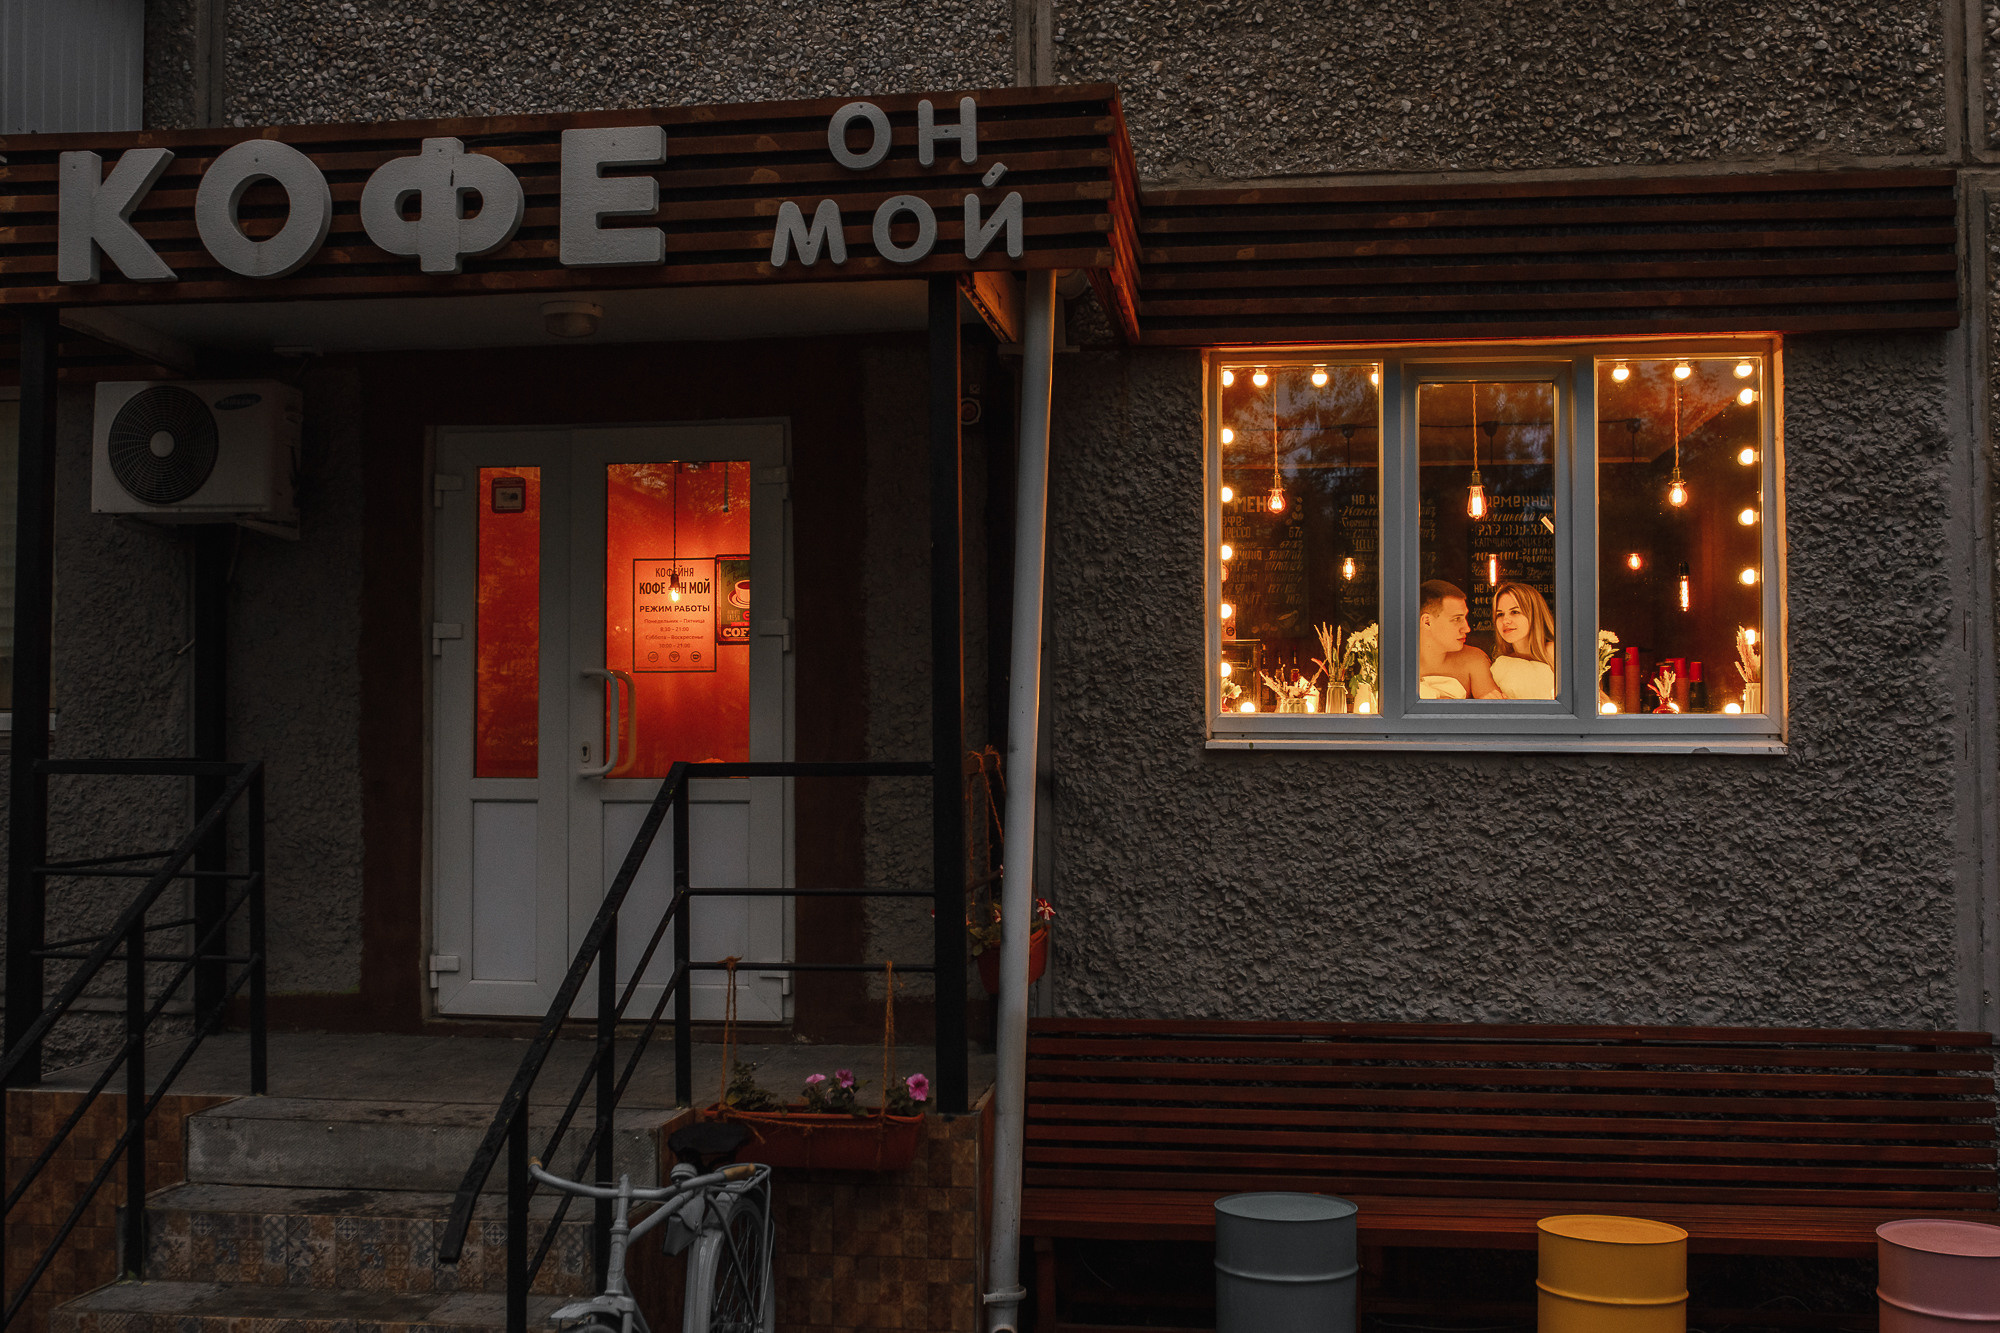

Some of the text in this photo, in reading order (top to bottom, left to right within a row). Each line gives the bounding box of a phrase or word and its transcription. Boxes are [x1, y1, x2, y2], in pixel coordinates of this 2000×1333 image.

[827, 96, 978, 171] ОН
[57, 125, 668, 283] КОФЕ
[770, 162, 1024, 267] МОЙ
[1233, 496, 1272, 513] МЕН
[655, 565, 694, 579] КОФЕЙНЯ
[639, 583, 666, 595] КОФЕ
[689, 578, 710, 594] МОЙ
[674, 604, 710, 612] РАБОТЫ
